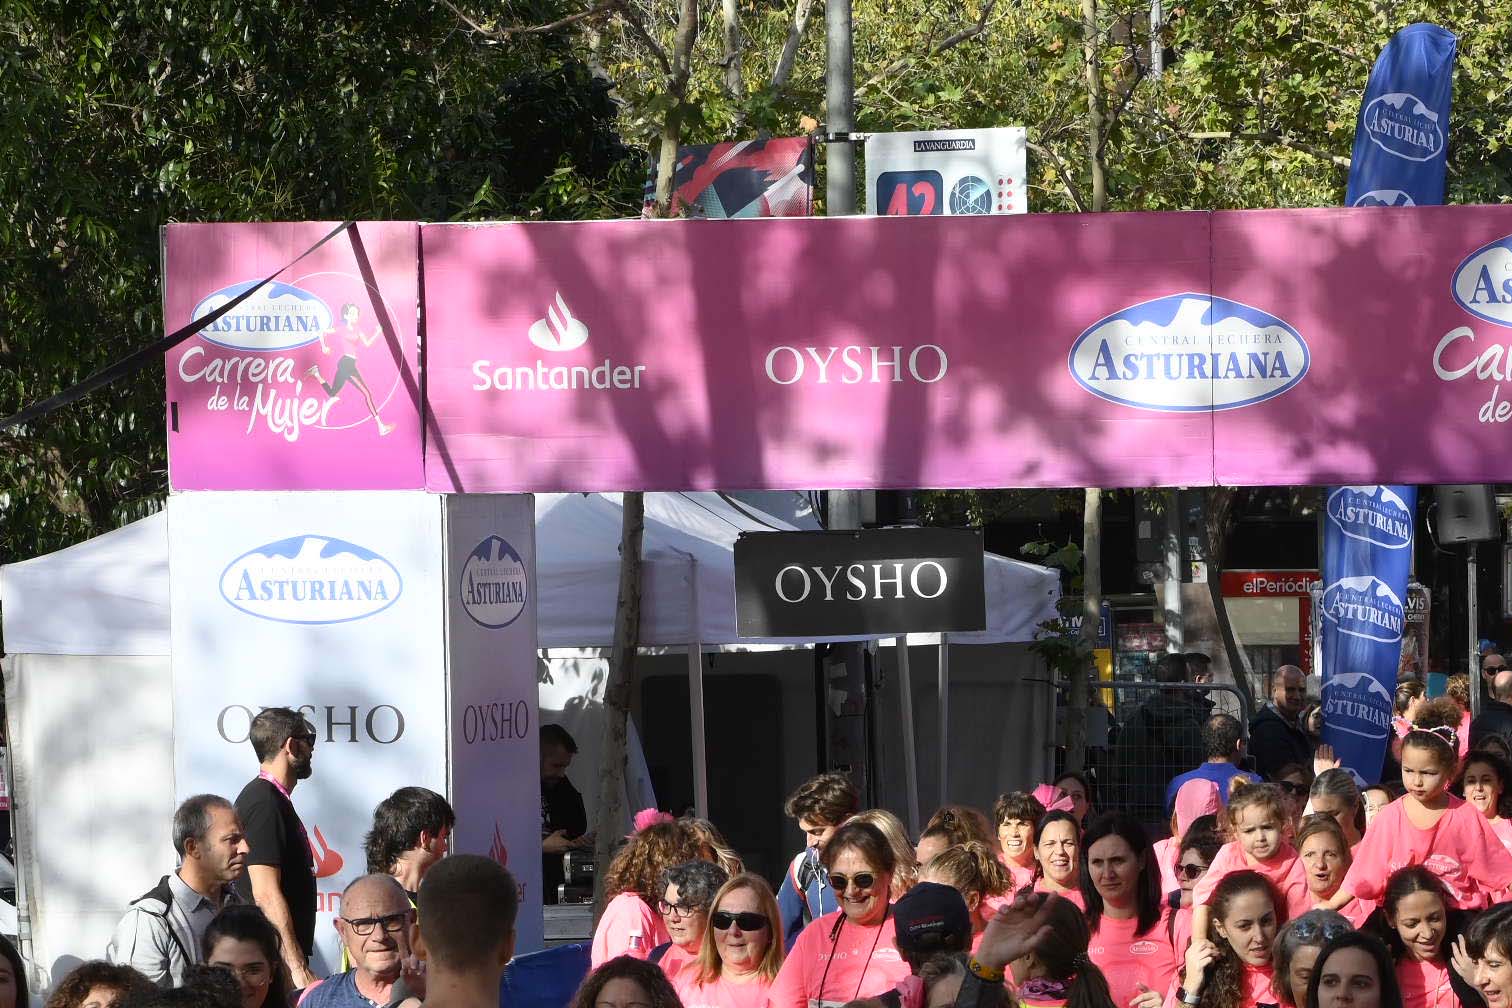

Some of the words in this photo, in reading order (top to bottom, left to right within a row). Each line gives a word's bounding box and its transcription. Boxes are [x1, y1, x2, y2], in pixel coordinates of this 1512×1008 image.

[1088, 338, 1292, 382] ASTURIANA
[1125, 335, 1203, 347] CENTRAL
[178, 346, 295, 383] Carrera
[473, 359, 646, 391] Santander
[765, 344, 948, 385] OYSHO
[207, 385, 228, 411] de
[233, 384, 249, 411] la
[246, 380, 341, 442] Mujer
[1479, 385, 1512, 424] de
[1336, 495, 1408, 541] ASTURIANA
[234, 568, 389, 602] ASTURIANA
[466, 569, 523, 605] ASTURIANA
[775, 560, 948, 604] OYSHO
[216, 703, 406, 744] OSHO
[463, 699, 530, 745] OYSHO
